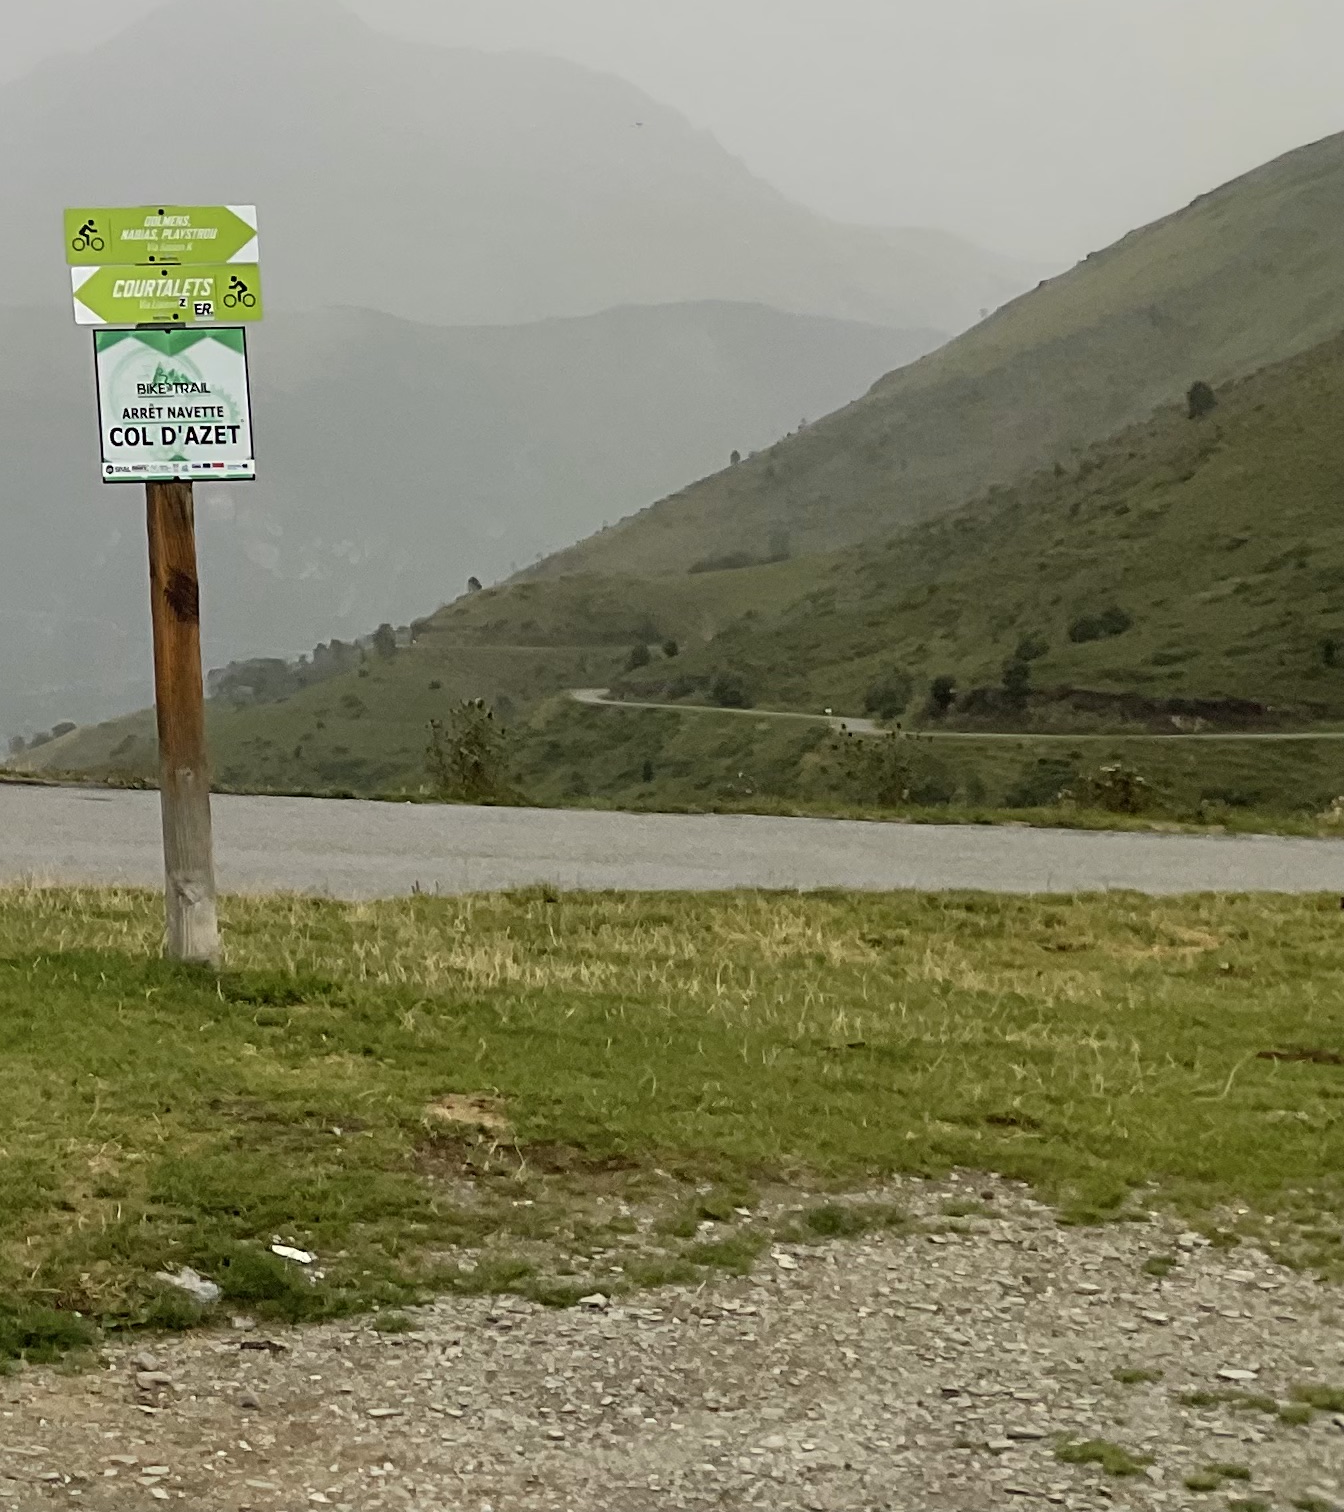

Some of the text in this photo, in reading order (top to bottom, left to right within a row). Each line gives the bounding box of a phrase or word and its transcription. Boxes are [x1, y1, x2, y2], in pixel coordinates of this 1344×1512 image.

[112, 278, 214, 298] COURTALETS
[137, 382, 211, 395] BIKE TRAIL
[122, 403, 224, 420] ARRÊT NAVETTE
[109, 425, 241, 447] COL D'AZET
